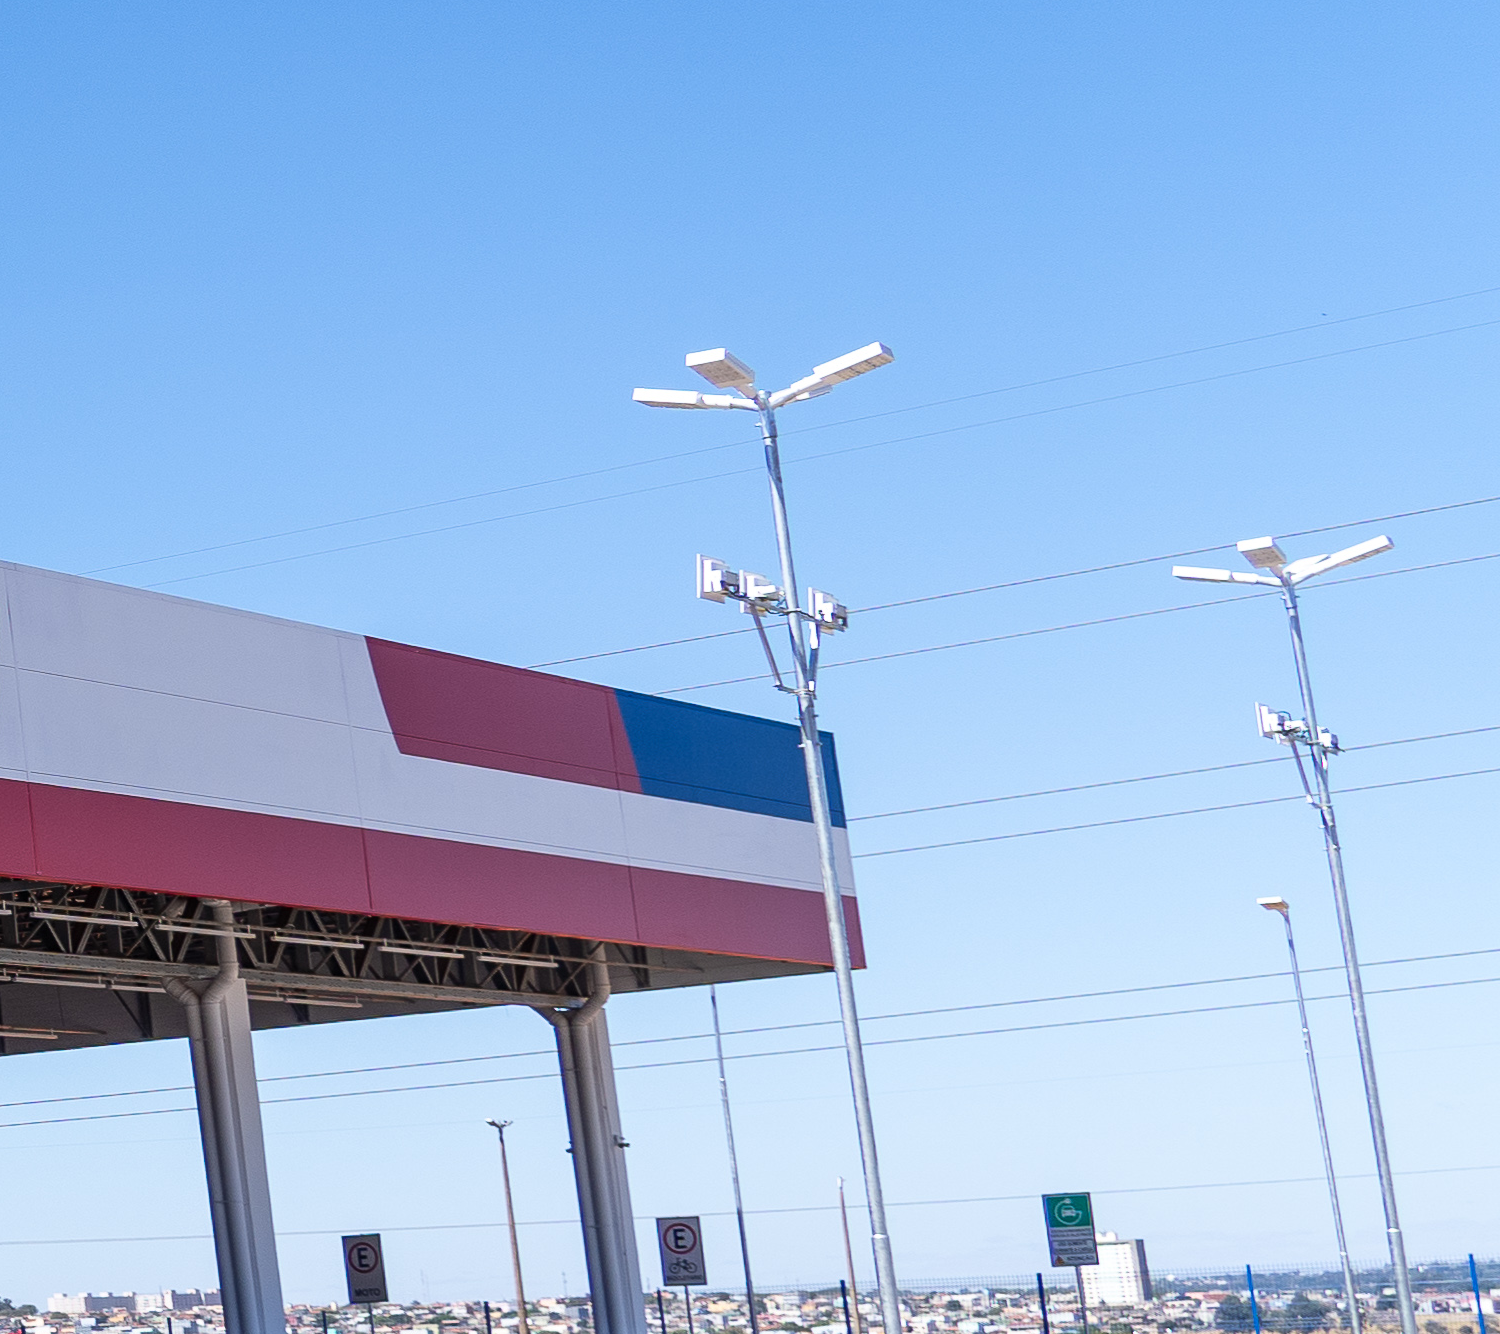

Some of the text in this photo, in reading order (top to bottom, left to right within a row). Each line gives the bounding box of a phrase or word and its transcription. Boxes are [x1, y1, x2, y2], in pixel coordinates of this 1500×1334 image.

[672, 1228, 688, 1249] E
[357, 1247, 370, 1268] E
[354, 1287, 381, 1297] MOTO
